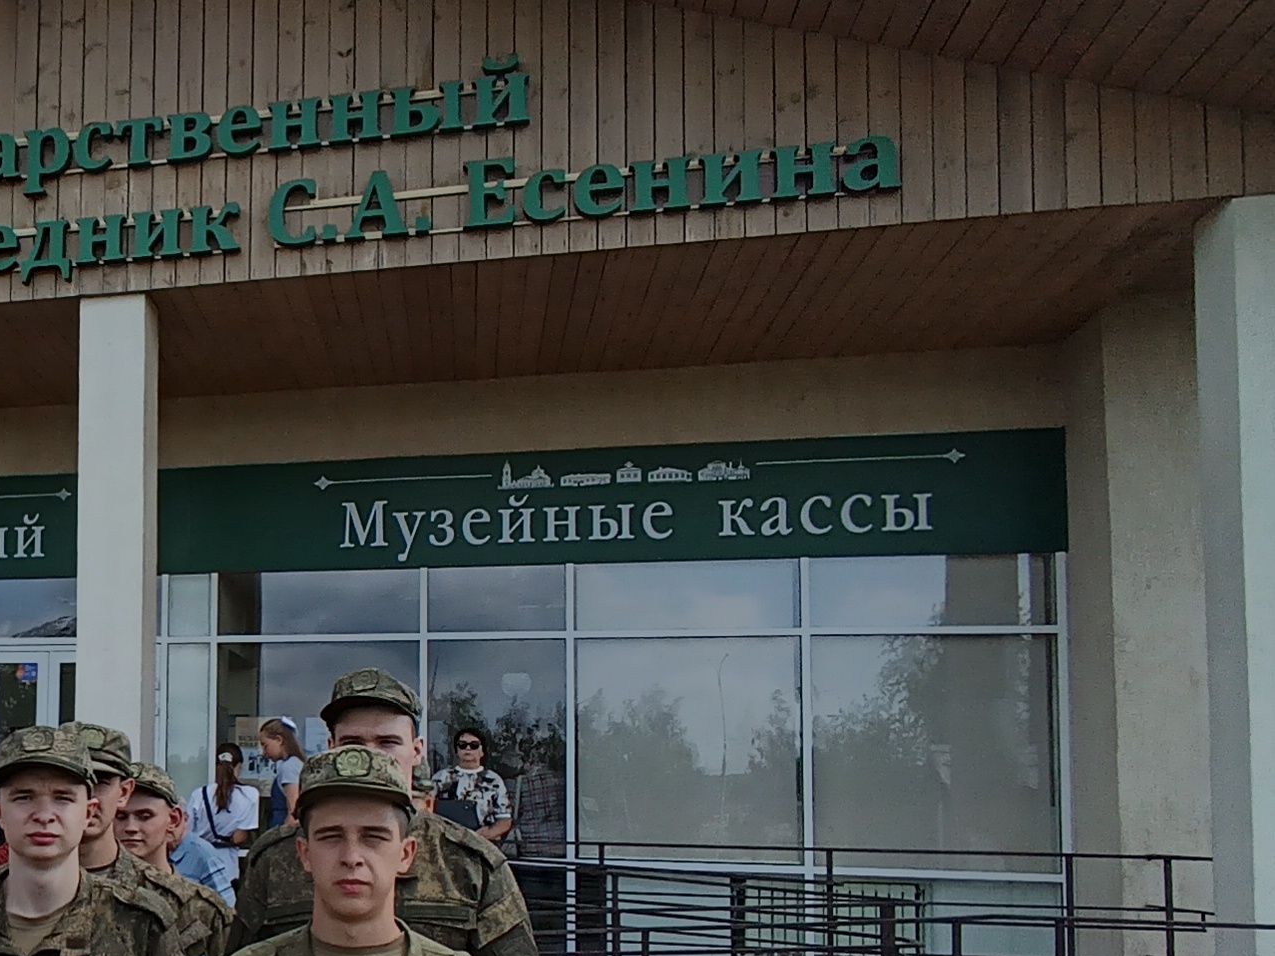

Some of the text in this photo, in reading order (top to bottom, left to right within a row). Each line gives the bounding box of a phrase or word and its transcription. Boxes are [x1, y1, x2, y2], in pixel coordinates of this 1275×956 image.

[267, 169, 431, 249] С.А.
[462, 134, 903, 231] Есенина
[339, 490, 934, 562] Музейные кассы
